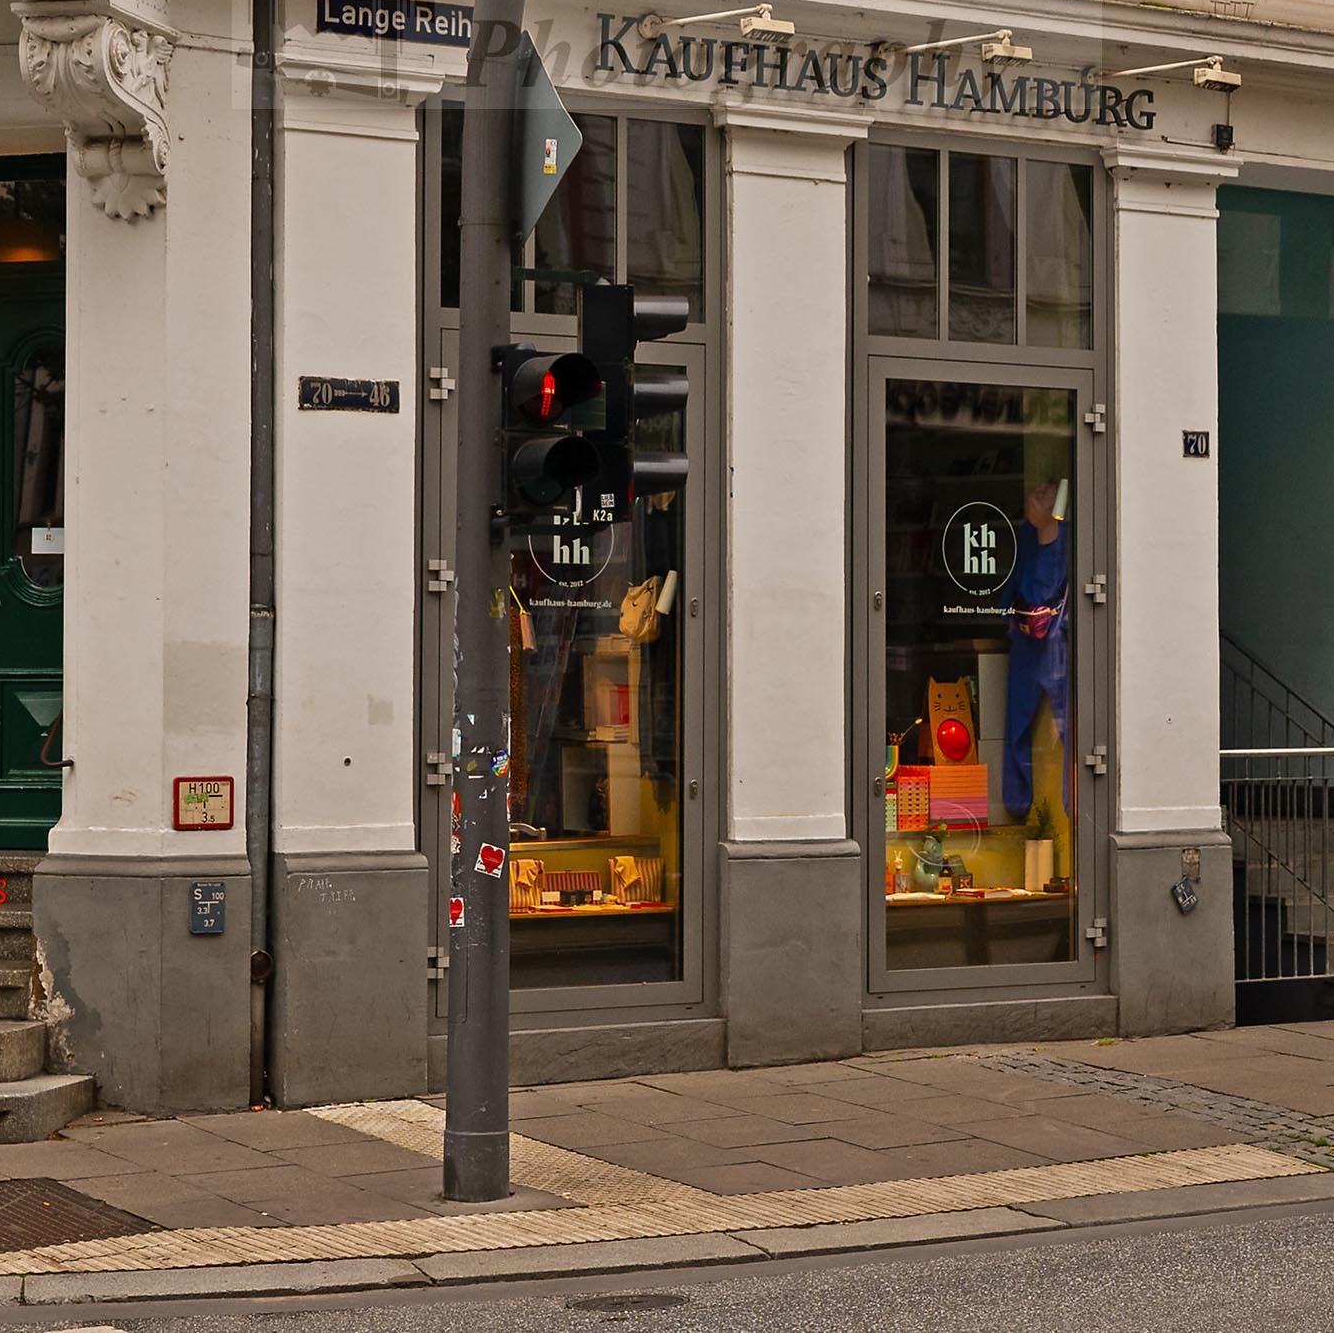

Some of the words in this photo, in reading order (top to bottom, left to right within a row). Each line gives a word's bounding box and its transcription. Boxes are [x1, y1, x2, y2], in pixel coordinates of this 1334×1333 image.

[415, 6, 471, 38] Reih
[596, 13, 888, 100] KAUFHAUS
[903, 54, 1157, 131] HAMBURG
[310, 381, 333, 405] 70
[1186, 433, 1207, 455] 70
[593, 509, 613, 522] K2a
[528, 598, 613, 610] kaufhaus-hamburg.de
[943, 605, 1016, 616] kaufhaus-hamburg.de
[193, 888, 203, 900] S
[211, 892, 225, 901] 100
